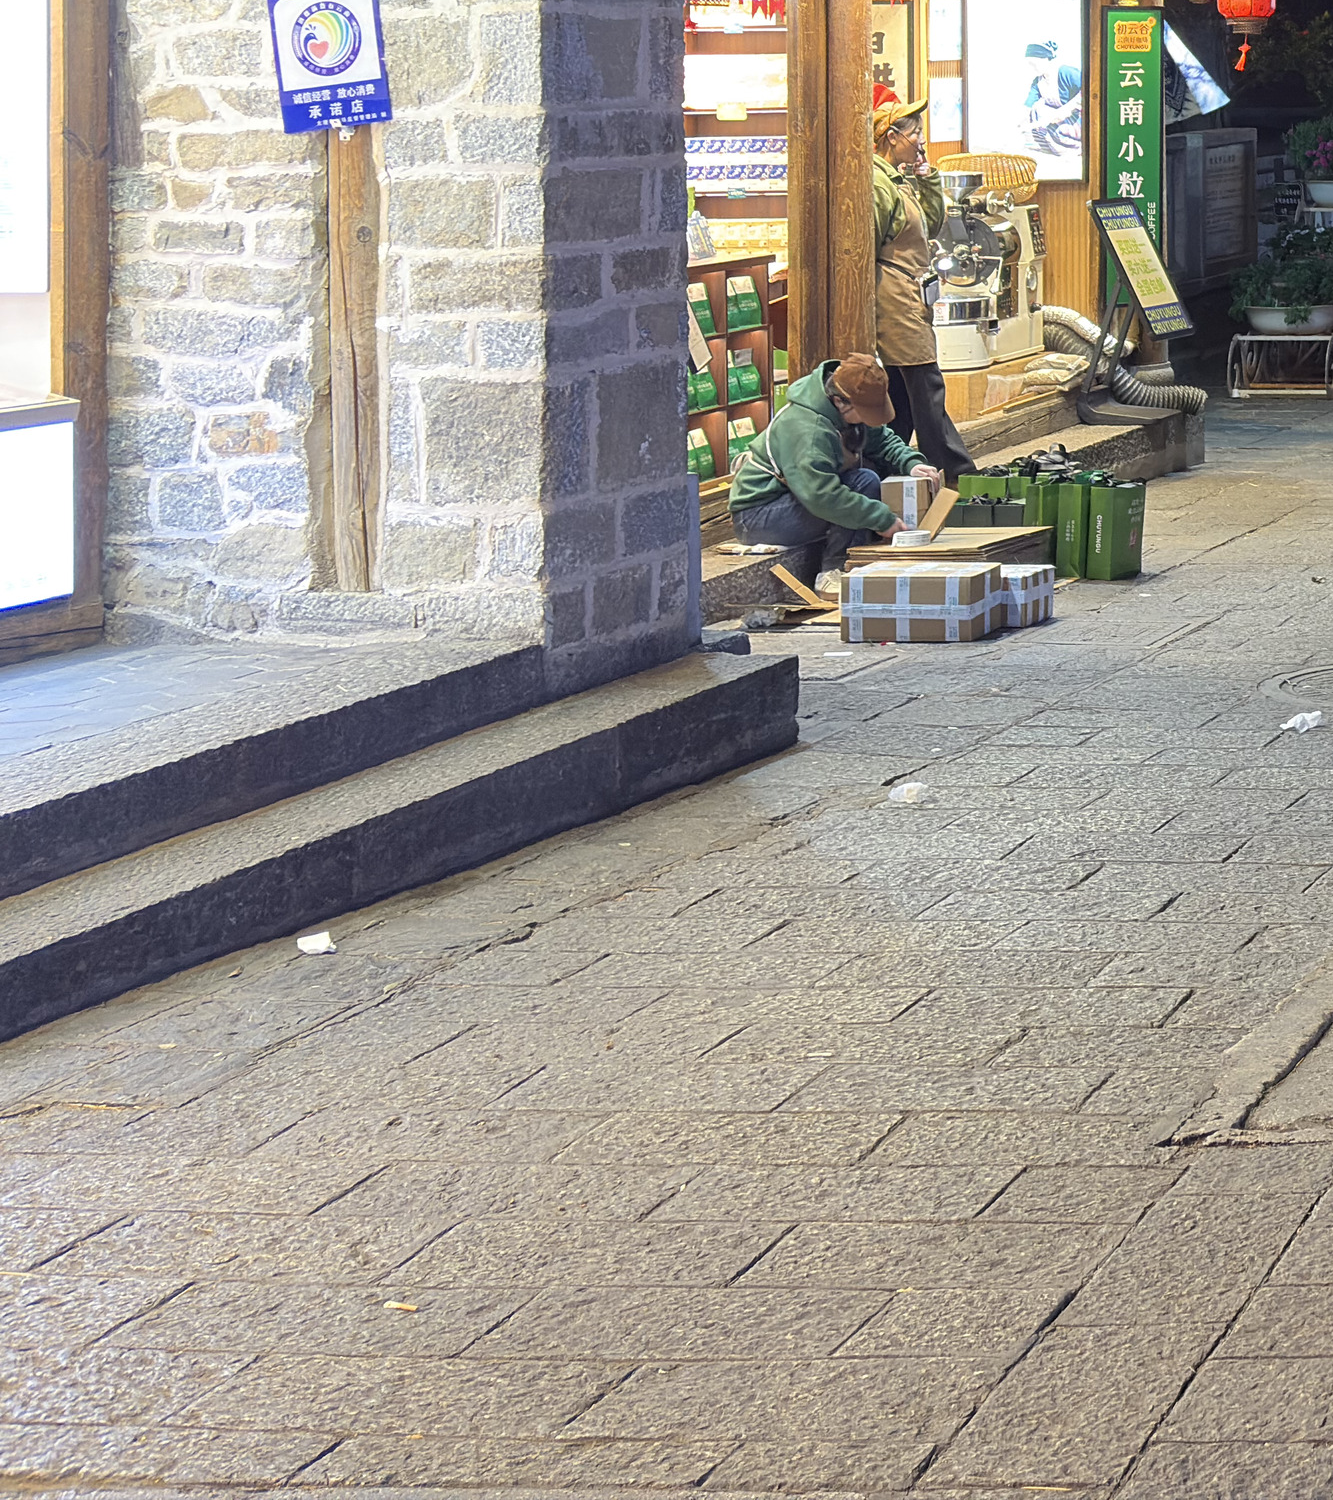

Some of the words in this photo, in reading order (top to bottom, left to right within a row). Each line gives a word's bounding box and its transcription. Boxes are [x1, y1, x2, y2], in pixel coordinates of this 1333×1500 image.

[1117, 24, 1149, 35] 初云谷
[293, 90, 331, 104] 诚信经营
[337, 85, 375, 99] 放心消费
[309, 100, 364, 119] 承诺店
[1118, 61, 1145, 198] 云南小粒
[1096, 205, 1133, 218] CHUYUNGU
[1102, 216, 1139, 230] CHUYUNGU
[1145, 305, 1182, 321] CHUYUNGU
[1151, 318, 1188, 334] CHUYUNGU
[1095, 514, 1103, 554] CHUYUNGU
